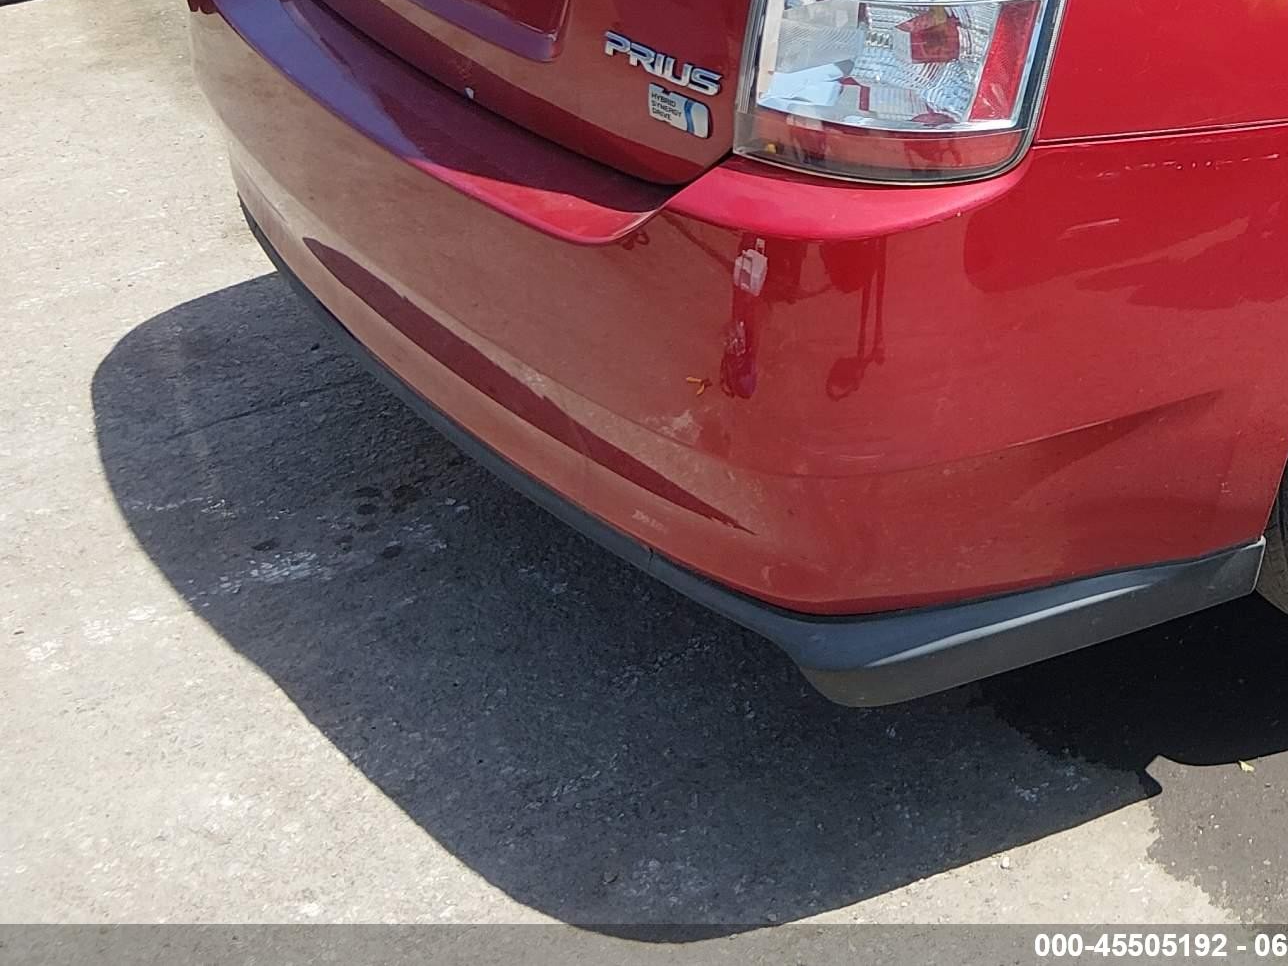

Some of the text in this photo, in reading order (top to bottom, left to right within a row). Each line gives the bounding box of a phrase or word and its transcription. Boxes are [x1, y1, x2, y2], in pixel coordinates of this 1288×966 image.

[603, 29, 722, 96] PRIUS
[651, 91, 676, 107] HYBRID
[651, 99, 682, 117] SYNERGY
